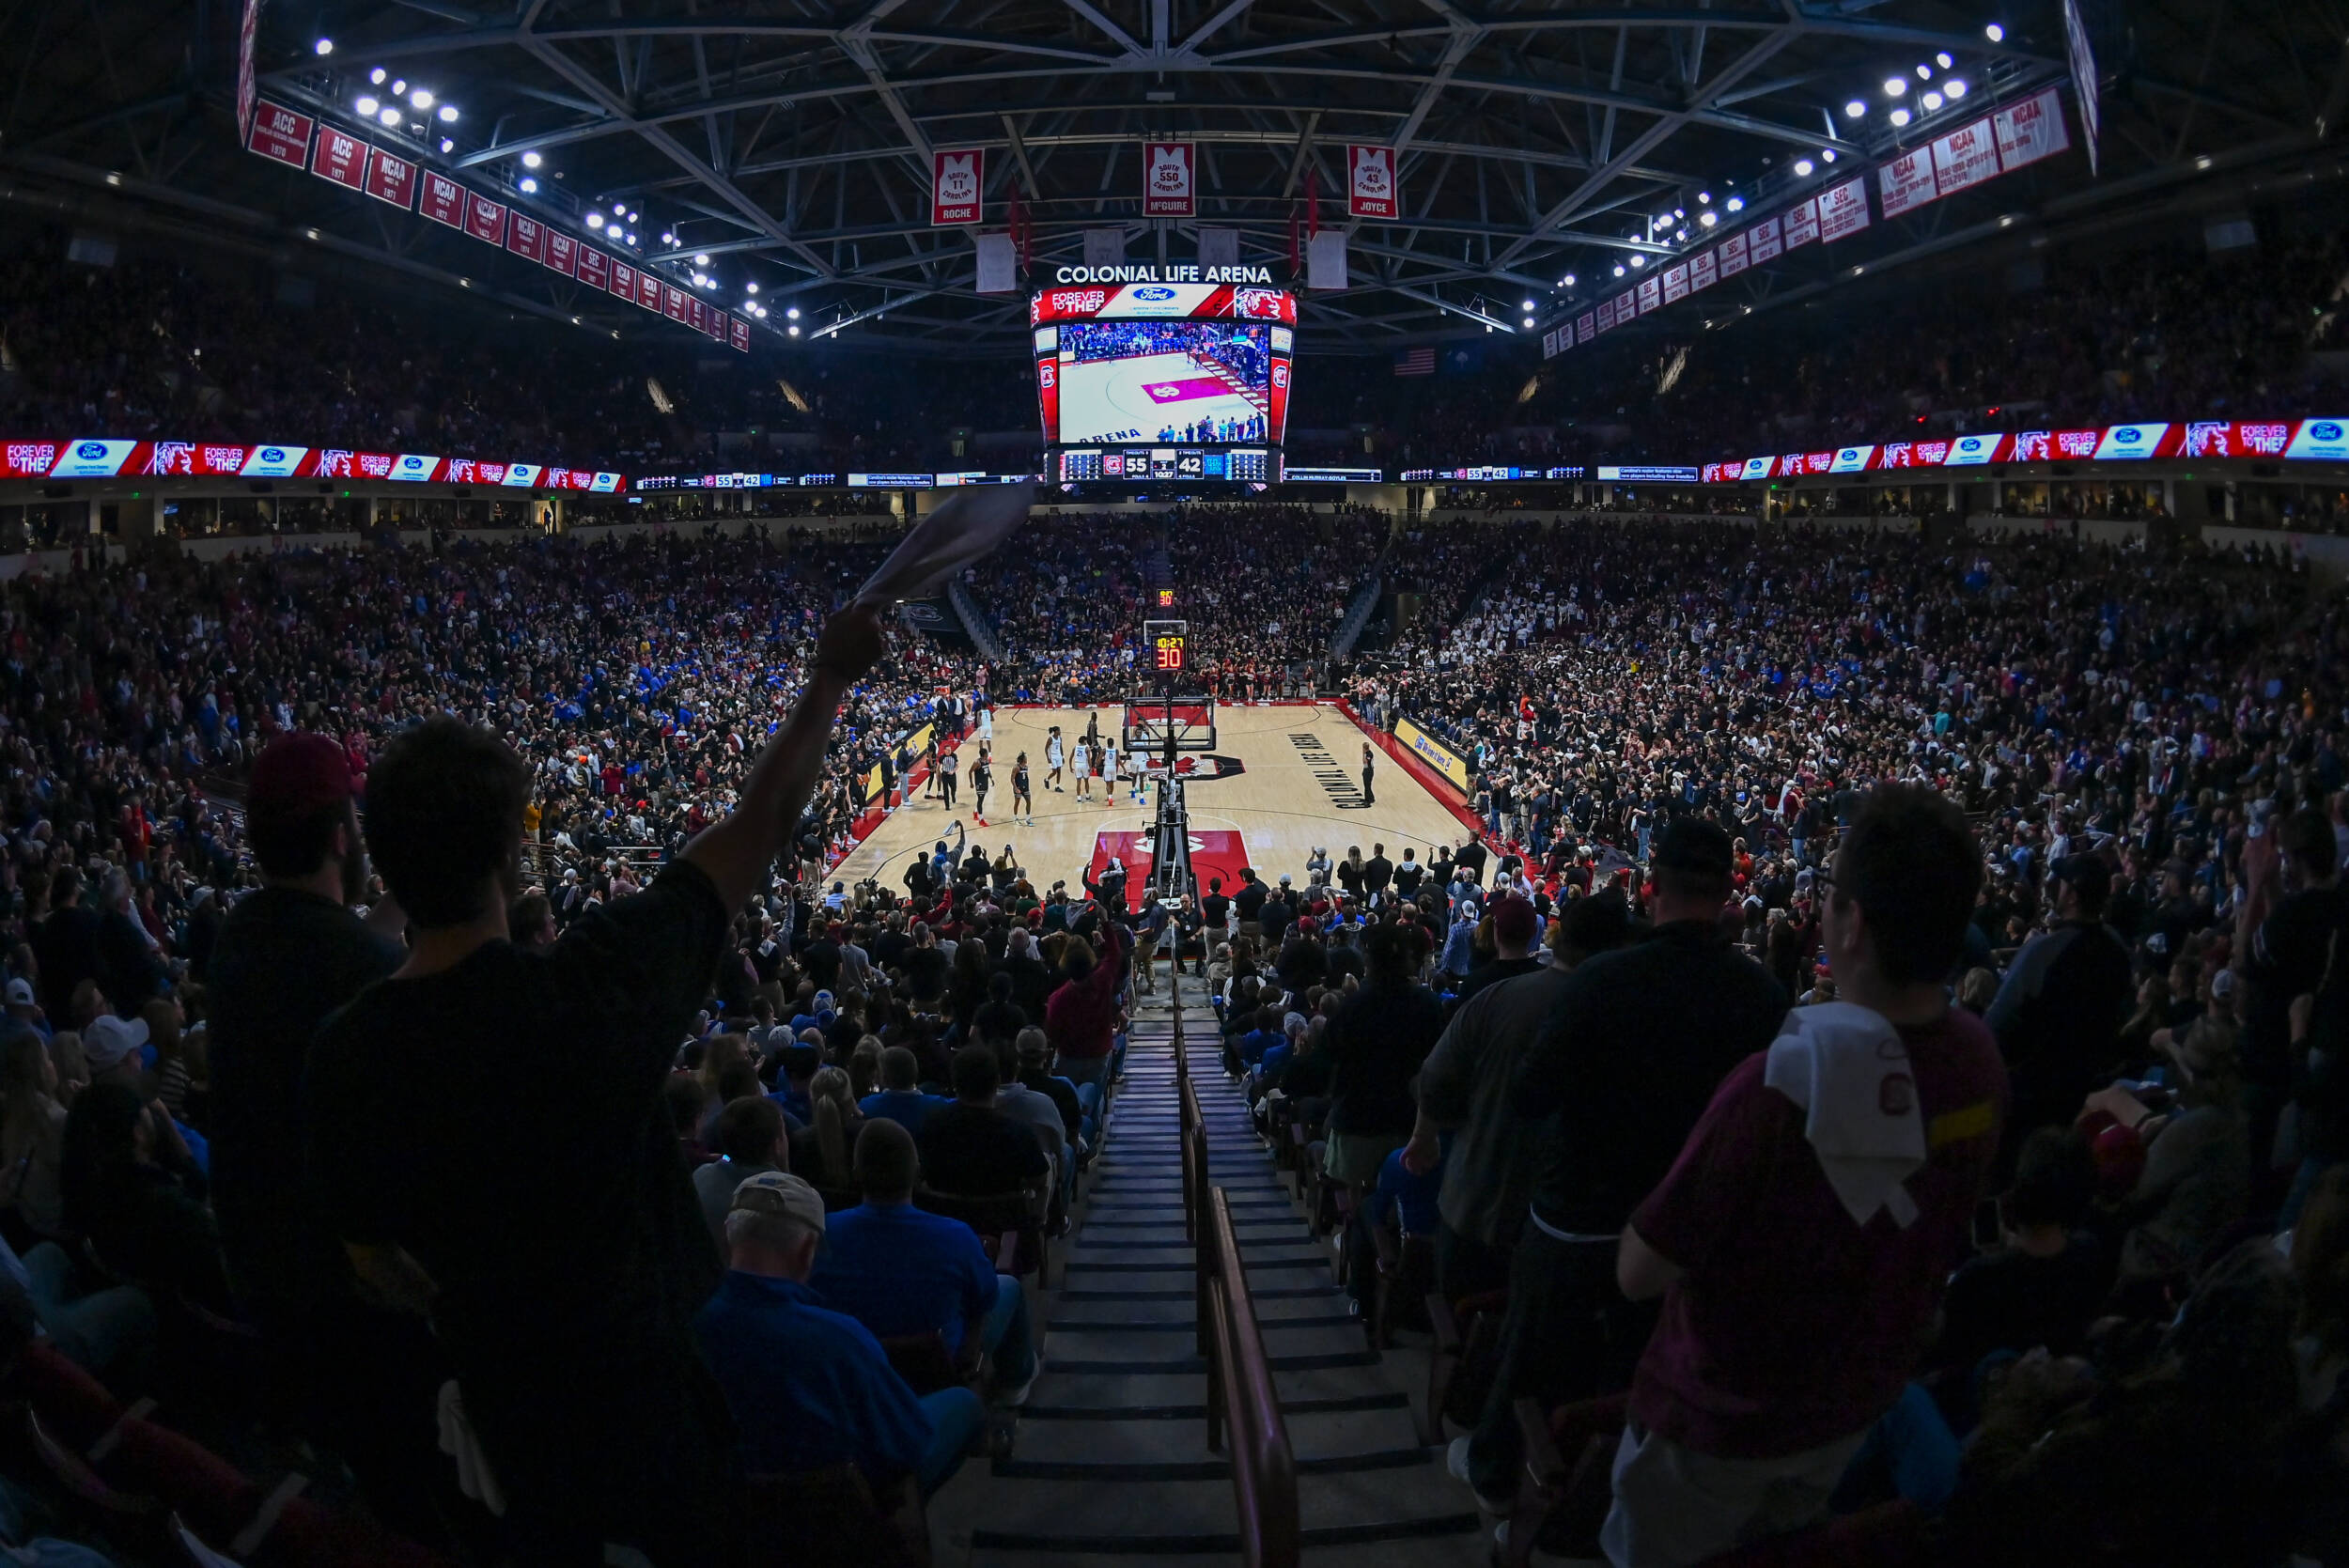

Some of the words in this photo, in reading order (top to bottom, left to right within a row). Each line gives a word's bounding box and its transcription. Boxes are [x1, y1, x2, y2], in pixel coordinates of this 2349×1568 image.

[2012, 100, 2042, 126] NCAA
[272, 111, 296, 134] ACC
[332, 135, 353, 159] ACC
[1949, 130, 1975, 153] NCAA
[381, 156, 406, 180] NCAA
[1159, 163, 1180, 172] SOUTH
[1361, 165, 1382, 174] SOUTH
[1892, 157, 1915, 179] NCAA
[948, 171, 968, 180] SOUTH
[1159, 173, 1178, 181] 550
[1366, 174, 1378, 183] 43
[434, 179, 456, 202] NCAA
[954, 180, 963, 190] 11
[1154, 181, 1184, 192] CAROLINA
[1358, 181, 1387, 194] CAROLINA
[942, 189, 972, 199] CAROLINA
[1834, 187, 1848, 205] SEC
[477, 200, 497, 221] NCAA
[1361, 201, 1387, 212] JOYCE
[943, 209, 972, 219] ROCHE
[1793, 207, 1806, 224] SEC
[517, 218, 536, 238] NCAA
[1758, 225, 1769, 241] SEC
[552, 236, 569, 254] NCAA
[1728, 241, 1738, 255] SEC
[588, 252, 599, 267] SEC
[1698, 256, 1707, 270] SEC
[616, 264, 630, 281] NCAA
[1056, 265, 1159, 284] COLONIAL
[1165, 266, 1199, 282] LIFE
[1205, 266, 1272, 284] ARENA
[1671, 270, 1680, 282] SEC
[643, 278, 657, 293] NCAA
[1052, 291, 1105, 304] FOREVER
[1141, 287, 1168, 299] Ford
[2119, 429, 2135, 442] Ford
[2240, 426, 2287, 437] FOREVER
[2315, 424, 2336, 438] Ford
[2059, 432, 2096, 443] FOREVER
[2243, 437, 2254, 447] TO
[8, 445, 54, 458] FOREVER
[83, 445, 102, 457] Ford
[1917, 443, 1945, 453] FOREVER
[1964, 441, 1978, 450] Ford
[2060, 442, 2069, 452] TO
[205, 448, 242, 458] FOREVER
[264, 449, 281, 461] Ford
[1808, 454, 1830, 463] FOREVER
[8, 458, 20, 468] TO
[206, 458, 215, 467] TO
[361, 456, 390, 465] FOREVER
[1126, 458, 1147, 472] 55
[1179, 458, 1200, 472] 42
[480, 464, 504, 473] FOREVER
[1470, 470, 1480, 478] 55
[718, 476, 730, 485] 55
[746, 476, 758, 485] 42
[1159, 597, 1172, 606] 30
[1158, 638, 1184, 647] 10:27
[1158, 649, 1180, 668] 30
[1287, 734, 1325, 750] ARENA
[1300, 753, 1338, 766] LIFE
[1313, 769, 1372, 809] COLONIAL
